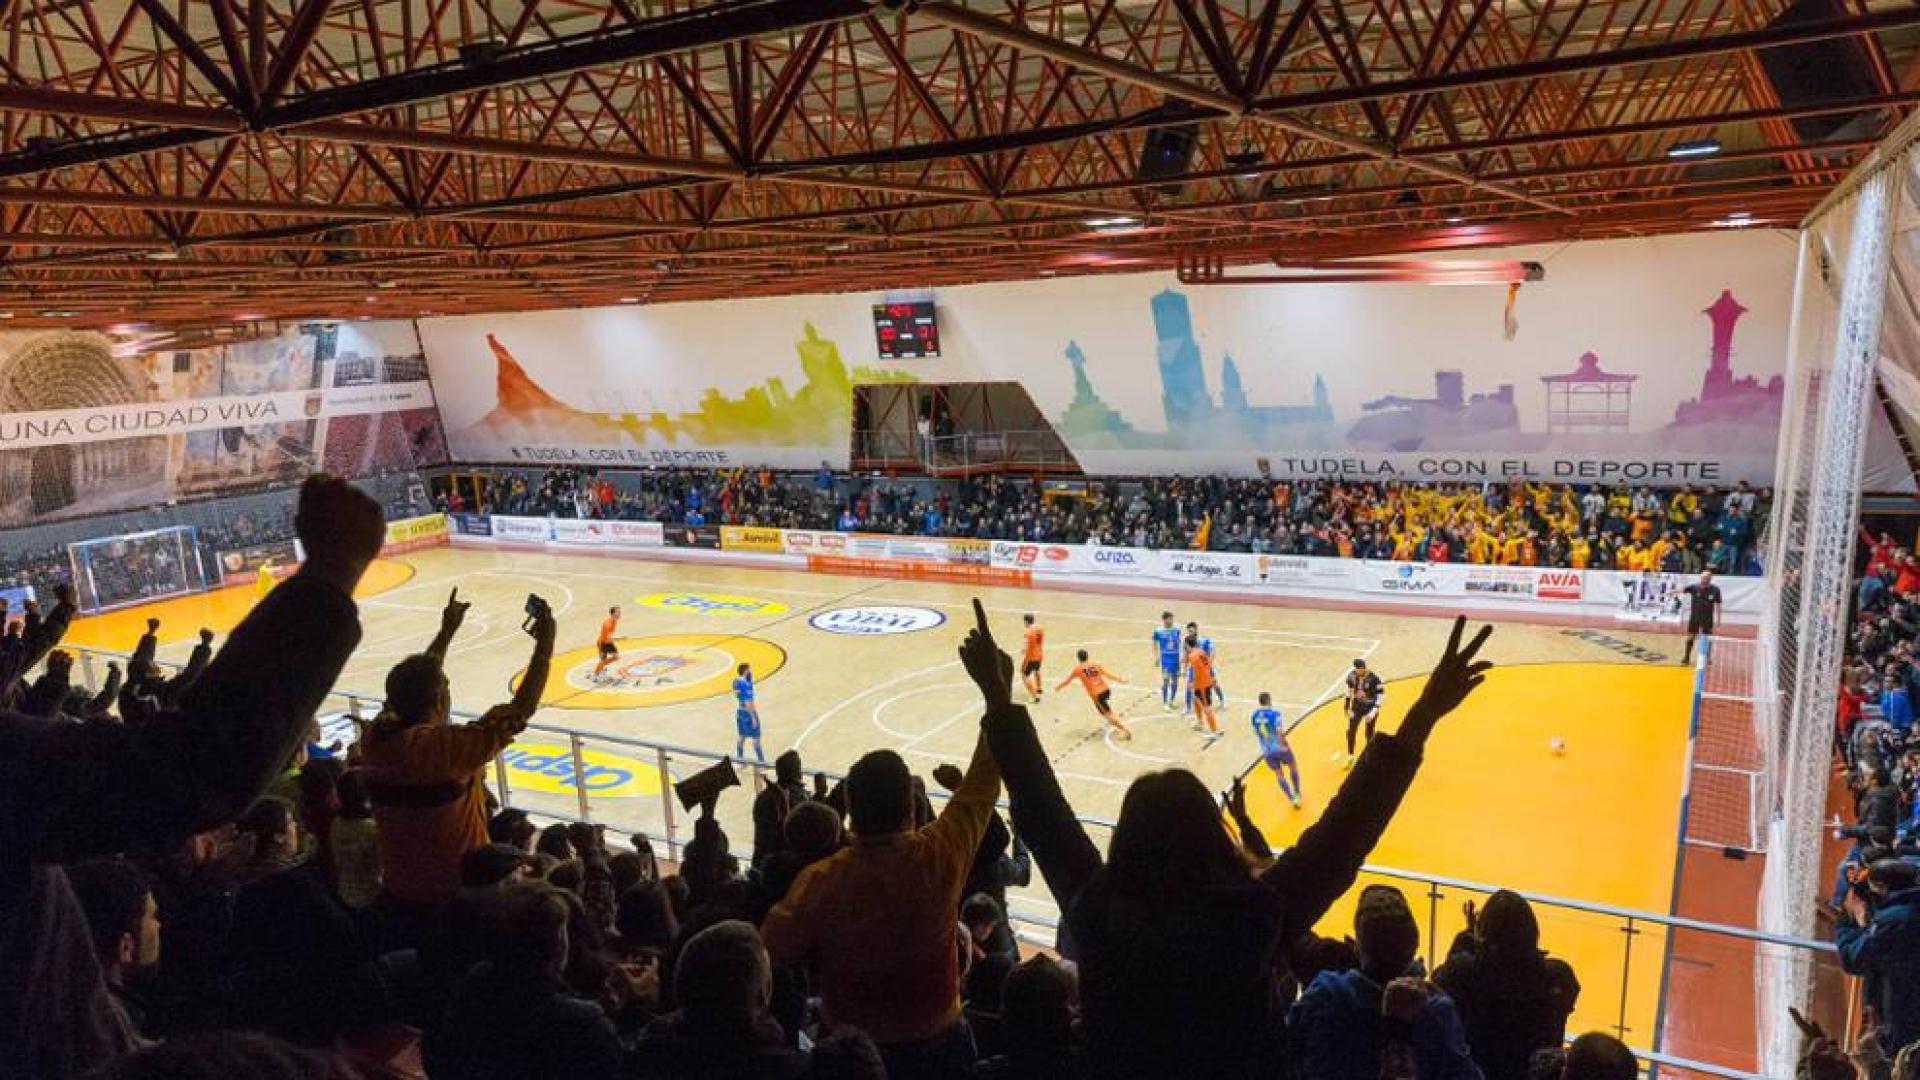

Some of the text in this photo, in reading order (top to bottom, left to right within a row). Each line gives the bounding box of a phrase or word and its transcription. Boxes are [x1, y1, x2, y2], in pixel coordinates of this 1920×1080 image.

[0, 400, 279, 441] UNA CIUDAD VIVA
[589, 449, 625, 461] CON
[651, 451, 729, 463] DEPORTE
[1417, 459, 1487, 476] CON
[1501, 460, 1539, 477] EL
[1553, 460, 1721, 480] DEPORTE
[1539, 571, 1581, 587] AVIA
